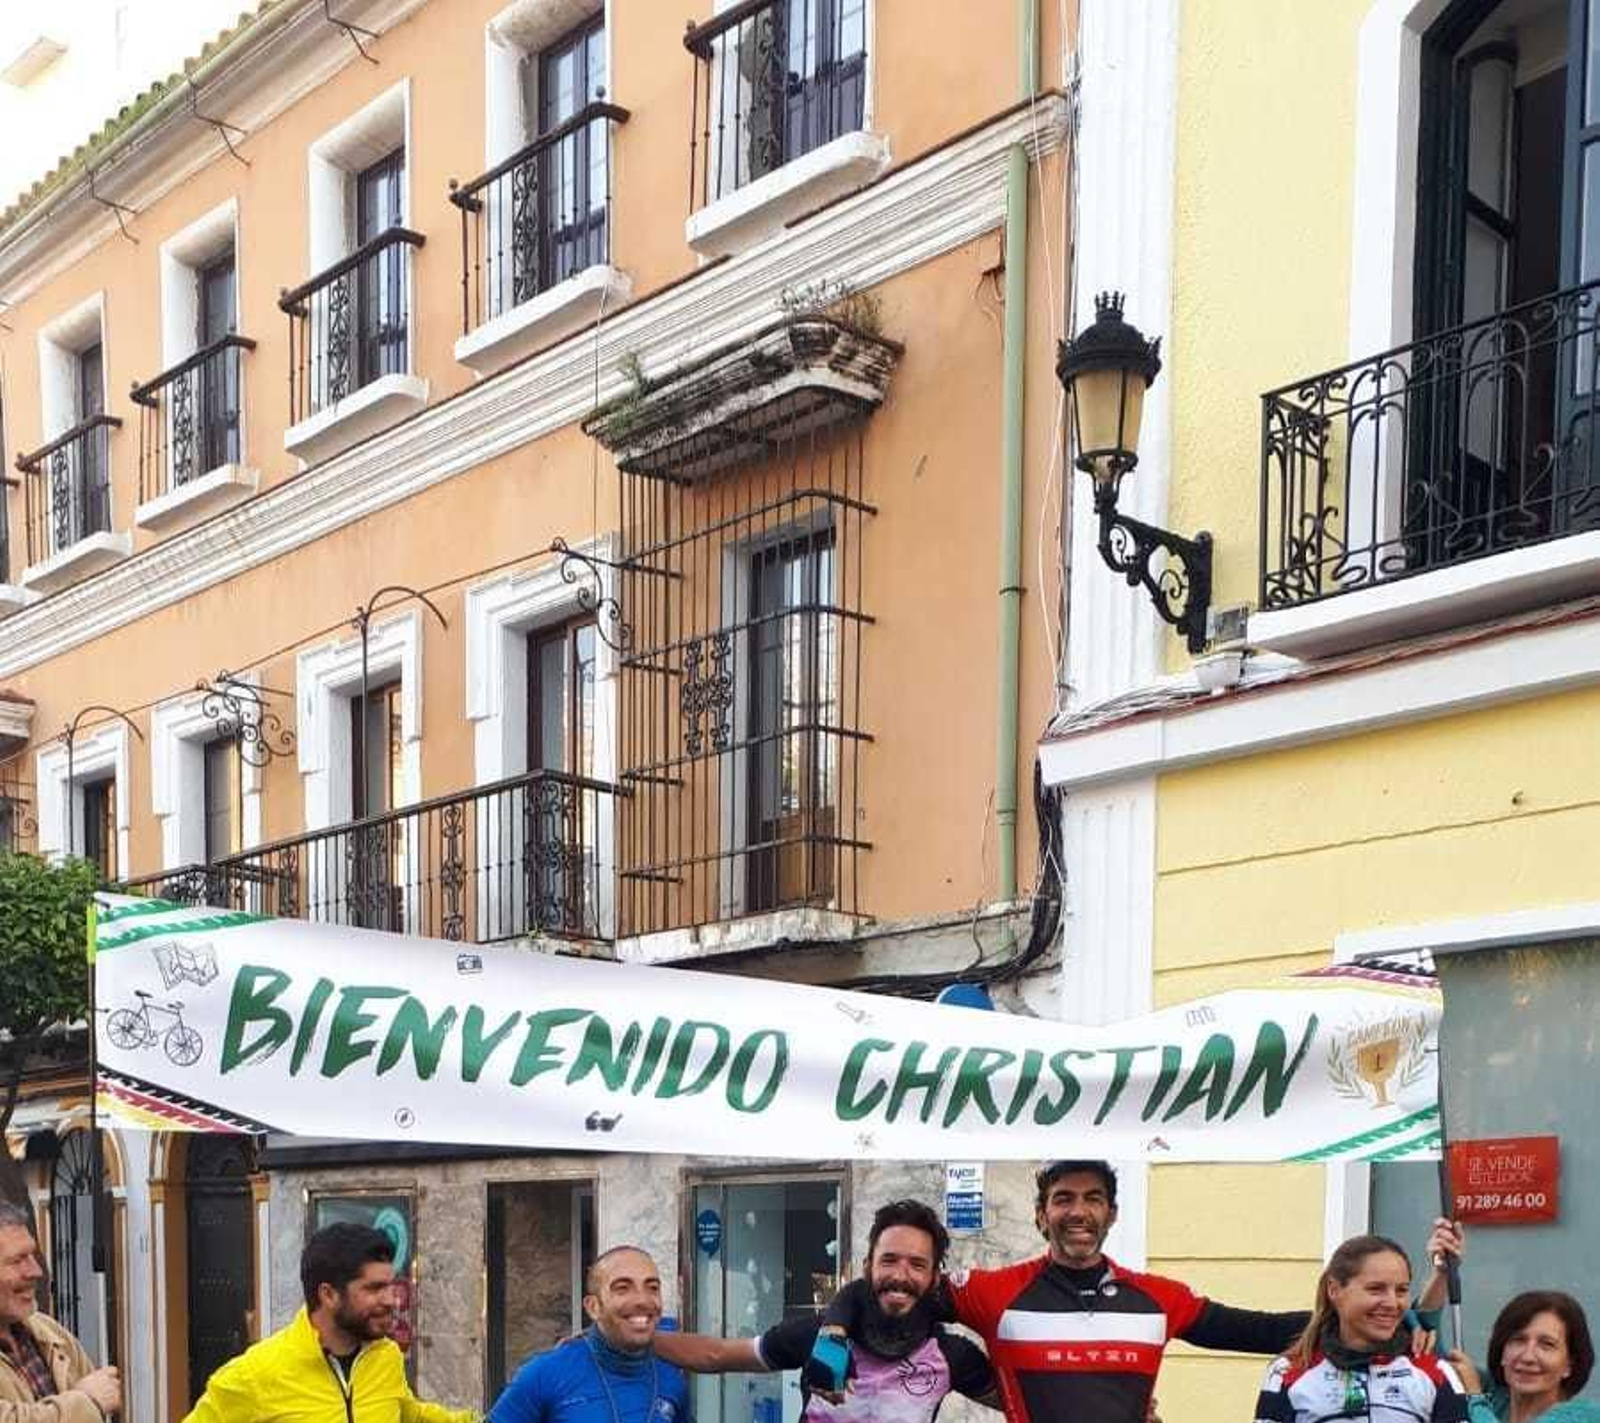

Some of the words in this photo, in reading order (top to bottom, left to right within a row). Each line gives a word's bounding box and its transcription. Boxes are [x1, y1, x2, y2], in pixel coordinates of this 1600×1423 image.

[220, 964, 789, 1113] BIENVENIDO
[835, 1012, 1319, 1127] CHRISTIAN
[1488, 1154, 1538, 1169] VENDE
[1456, 1195, 1472, 1209] 91
[1475, 1194, 1500, 1209] 289
[1503, 1193, 1522, 1208] 46
[1525, 1193, 1546, 1207] 00
